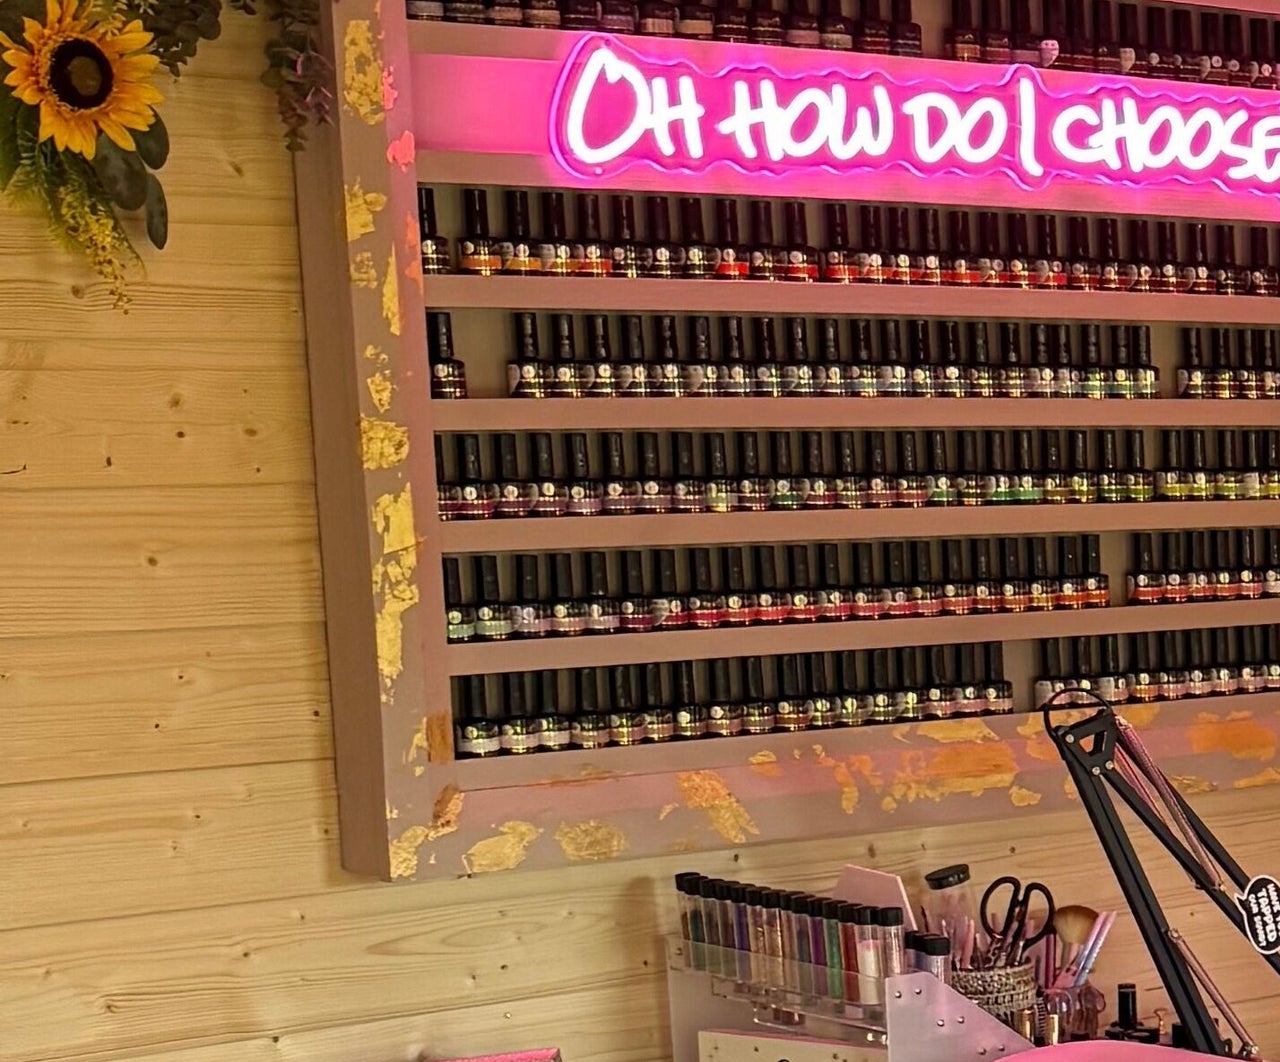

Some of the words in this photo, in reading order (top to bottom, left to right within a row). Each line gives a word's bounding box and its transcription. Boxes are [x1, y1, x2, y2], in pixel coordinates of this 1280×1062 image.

[567, 47, 705, 164] OH
[717, 78, 894, 162] HOW
[903, 88, 1008, 163] DO
[1017, 76, 1044, 178] I
[1256, 887, 1278, 943] TAPPED
[1267, 883, 1280, 913] HAVE
